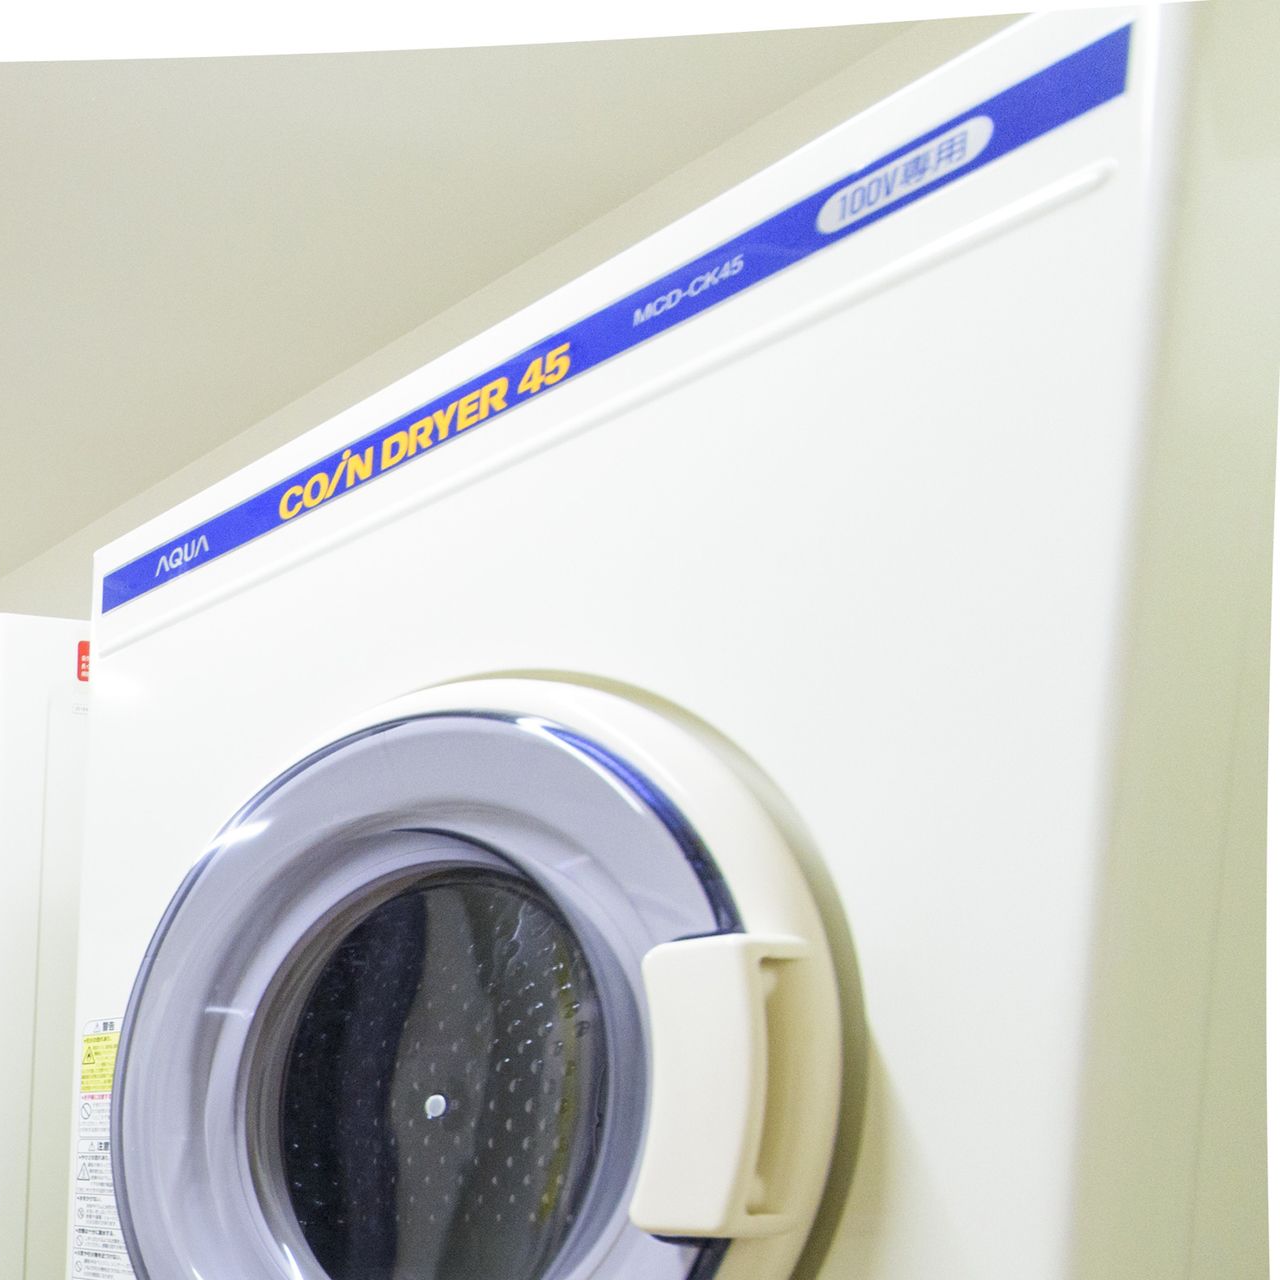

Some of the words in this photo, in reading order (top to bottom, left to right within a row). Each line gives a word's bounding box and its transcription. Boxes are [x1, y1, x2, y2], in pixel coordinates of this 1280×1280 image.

[633, 255, 744, 326] MCD-CK45
[155, 534, 209, 578] AQUA
[380, 376, 509, 471] DRYER
[516, 341, 572, 395] 45
